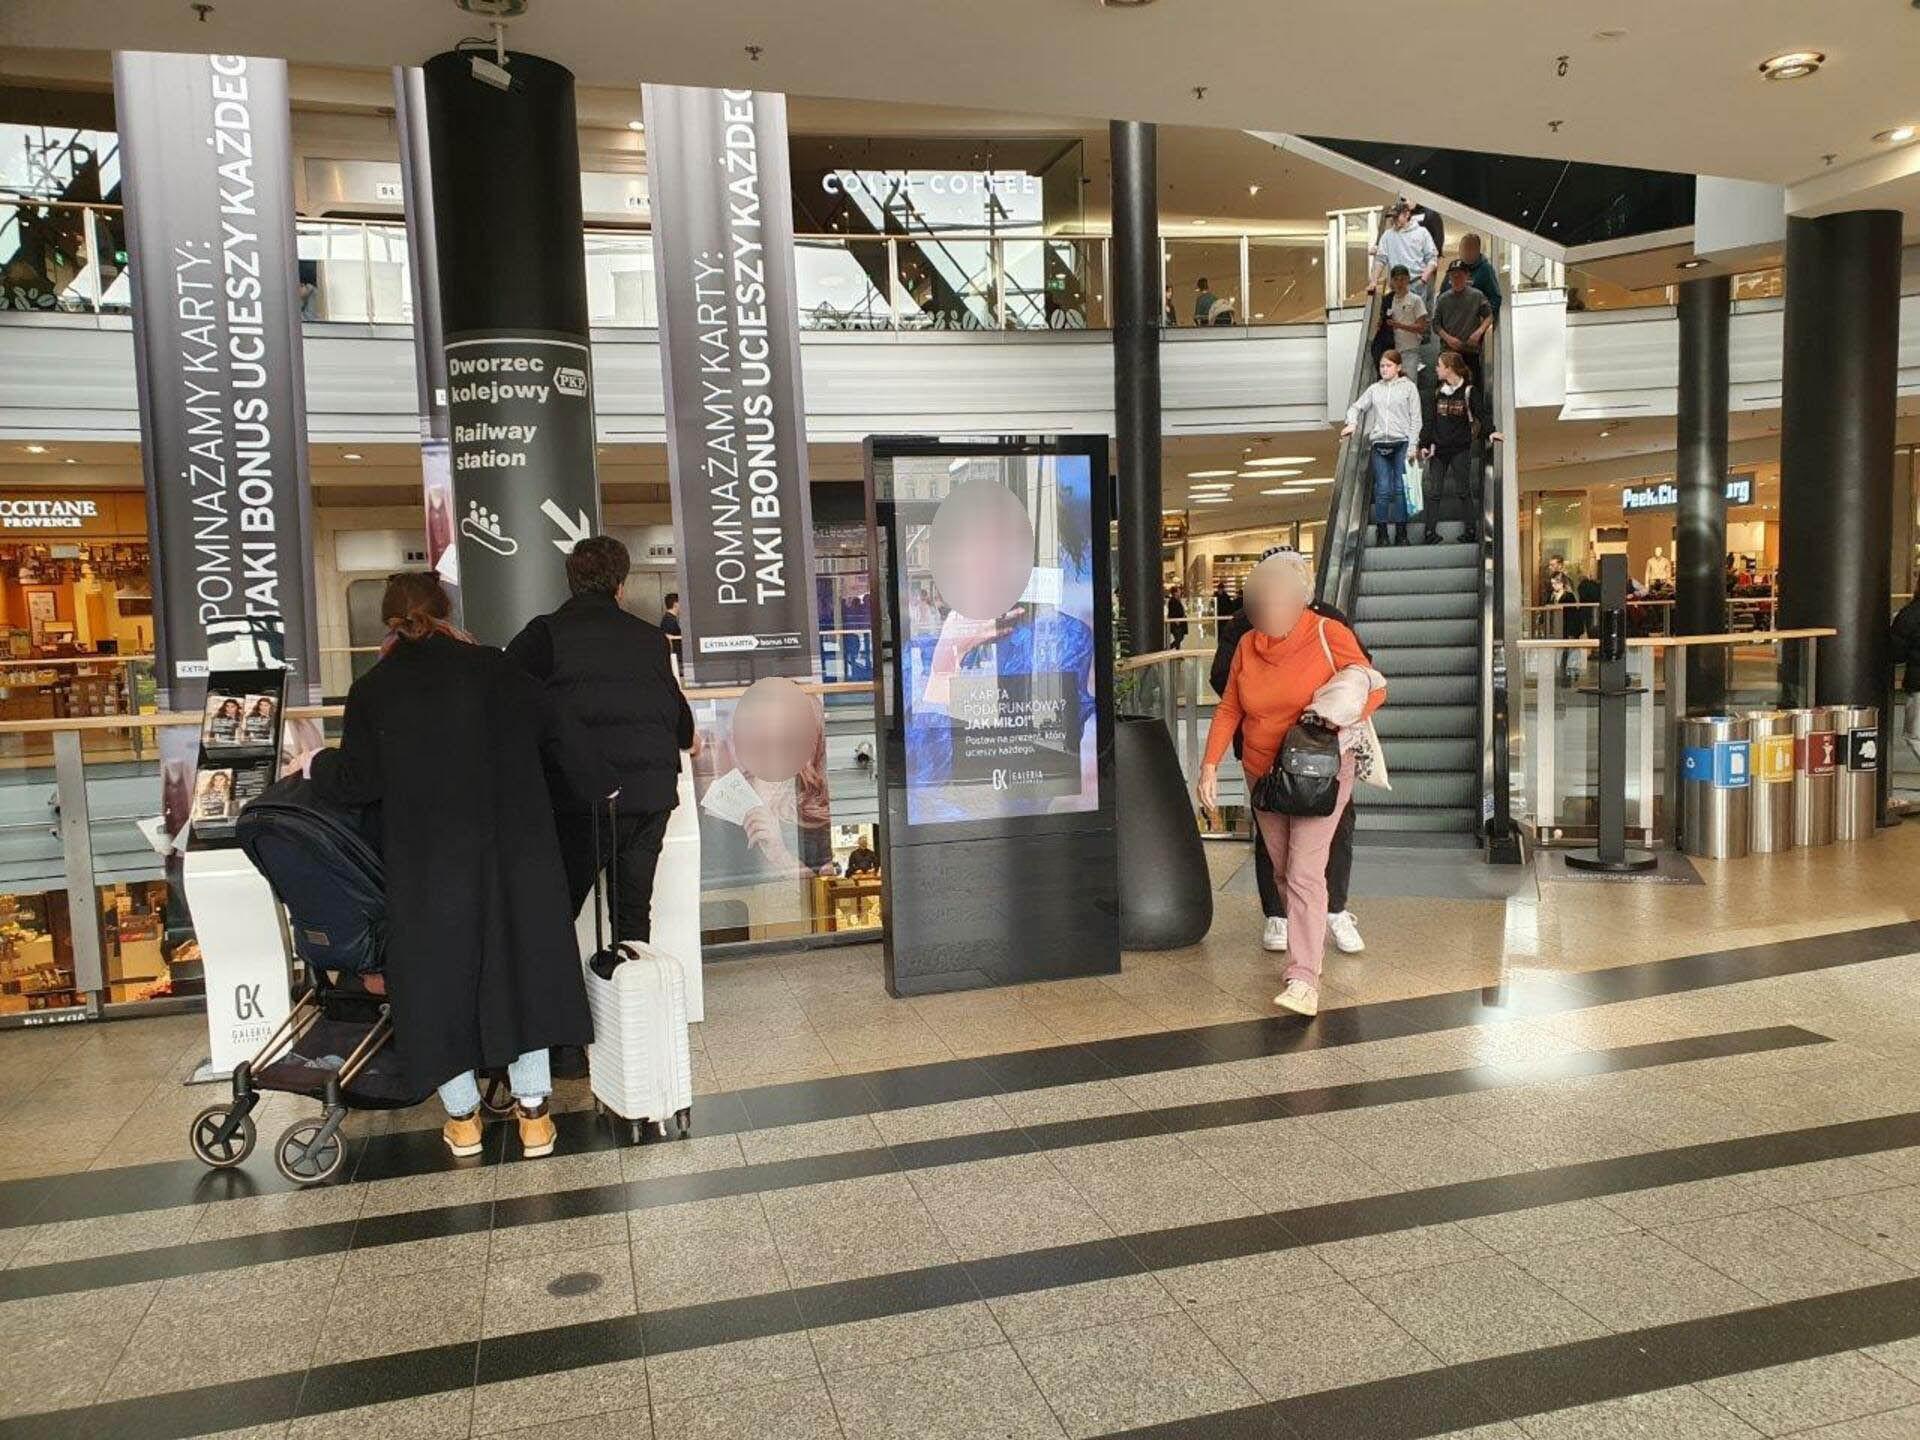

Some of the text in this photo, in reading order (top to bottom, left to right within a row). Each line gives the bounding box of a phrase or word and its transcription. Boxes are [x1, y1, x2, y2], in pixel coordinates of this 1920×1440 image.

[929, 174, 1035, 194] COFFEE
[222, 220, 268, 388] UCIESZY
[732, 231, 772, 387] UCIESZY
[449, 357, 545, 377] Dworzec
[559, 374, 585, 390] PKP
[451, 380, 550, 404] kolejowy
[174, 239, 235, 624] POMNAŻAMY KARTY:
[455, 422, 538, 444] Railway
[693, 251, 747, 605] POMNAŻAMY KARTY:
[233, 398, 276, 532] BONUS
[456, 449, 526, 470] station
[743, 394, 781, 519] BONUS
[242, 542, 281, 618] TAKI
[752, 527, 786, 605] TAKI
[760, 638, 783, 646] bonus
[783, 636, 800, 645] 10%
[964, 717, 991, 730] JAK
[234, 983, 265, 1021] GK
